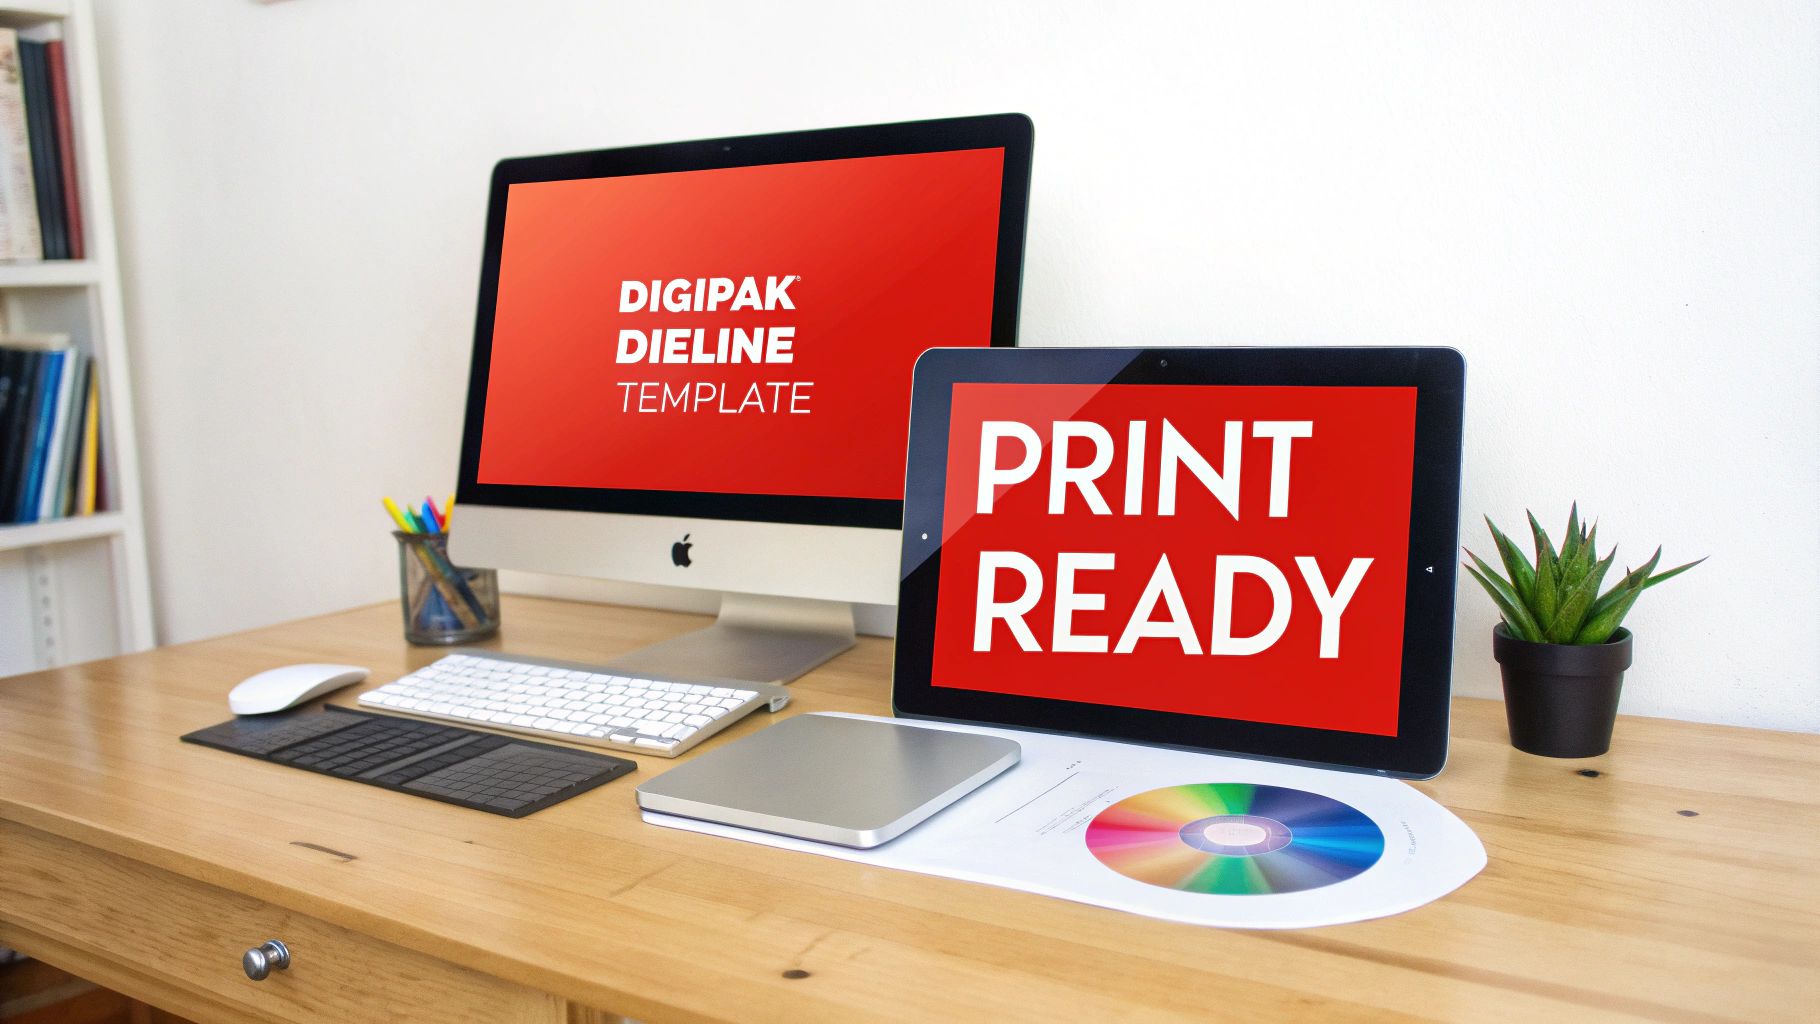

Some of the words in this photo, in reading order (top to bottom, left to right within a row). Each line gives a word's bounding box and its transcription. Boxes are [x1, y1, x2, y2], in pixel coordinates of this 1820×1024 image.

[615, 326, 796, 364] DIELINE
[616, 381, 815, 414] TEMPLATE
[976, 418, 1314, 521] PRINT
[973, 550, 1376, 660] READY
